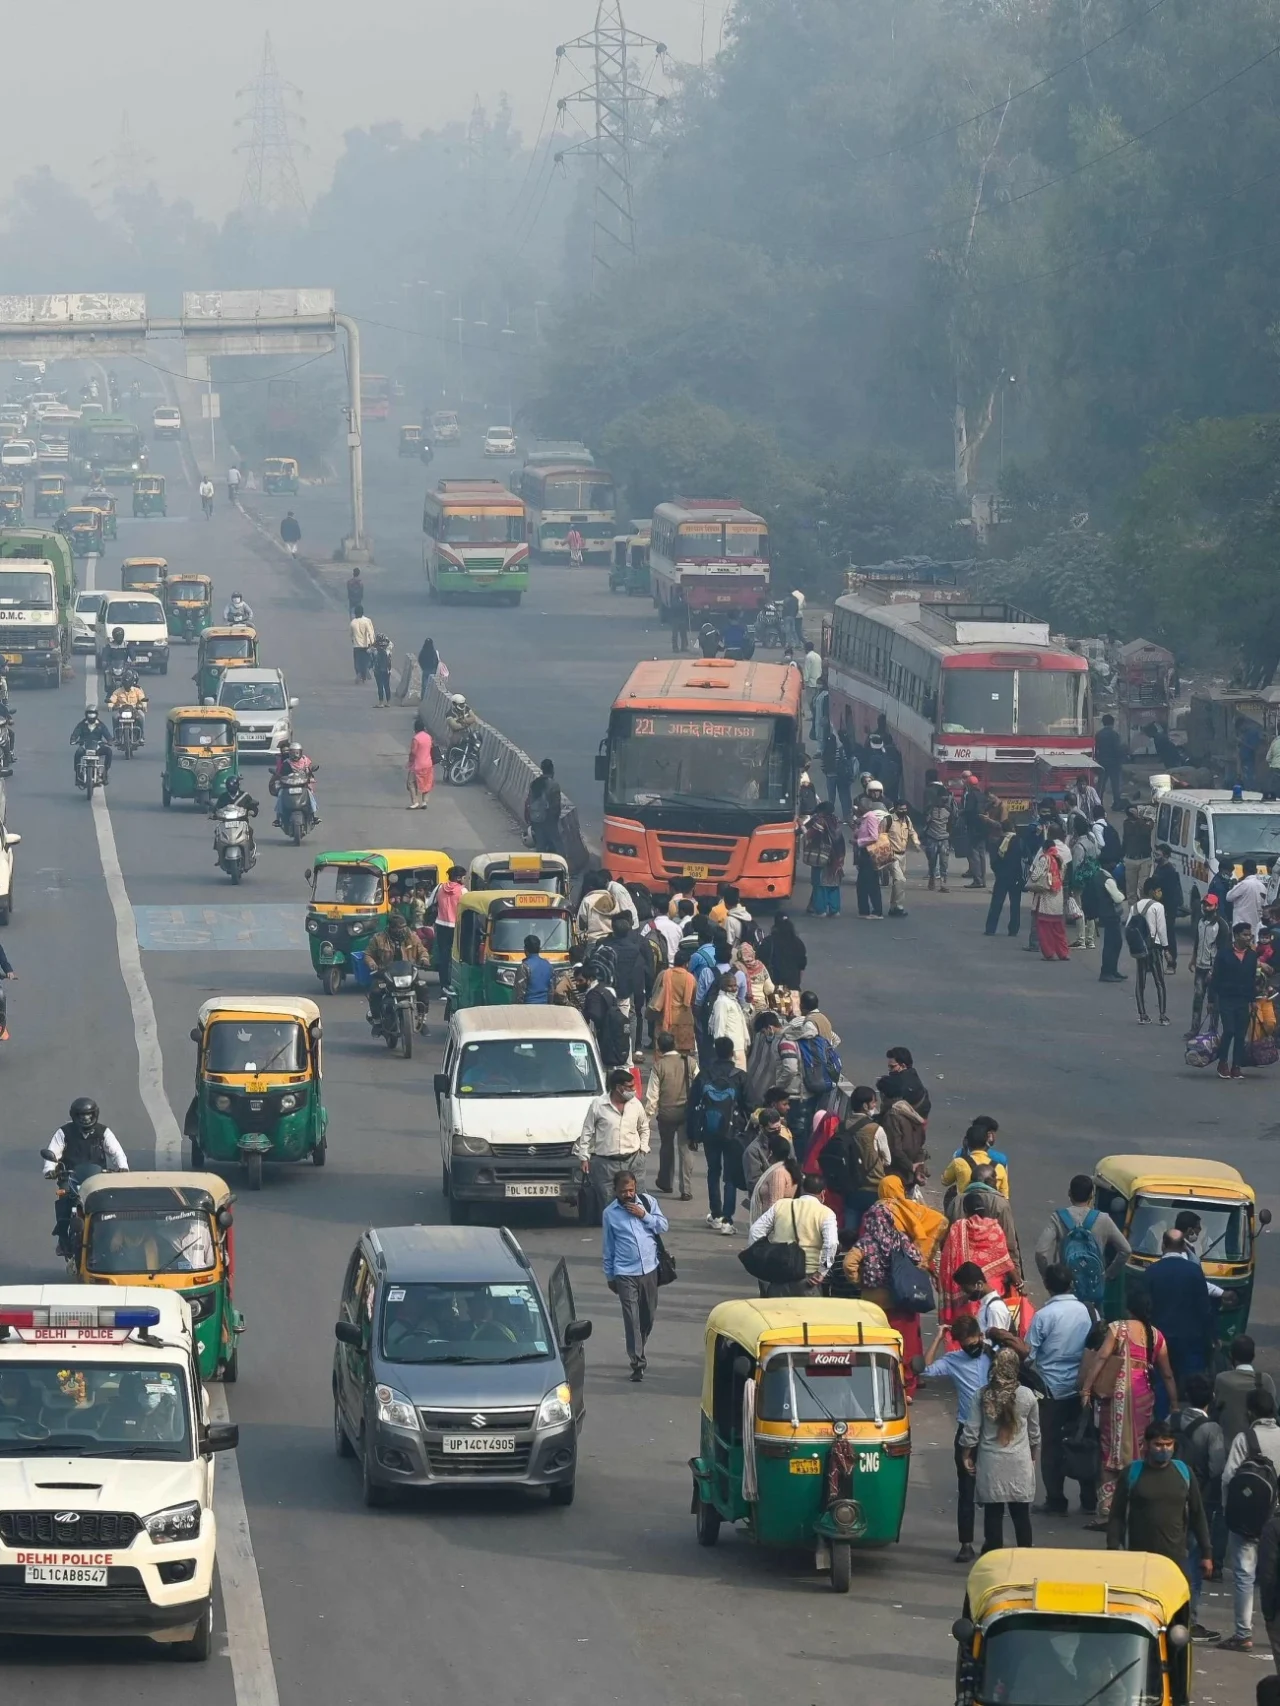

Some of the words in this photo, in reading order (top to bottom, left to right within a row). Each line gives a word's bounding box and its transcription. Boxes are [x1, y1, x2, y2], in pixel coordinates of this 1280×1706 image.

[635, 718, 655, 735] 221
[668, 721, 699, 737] आनंद
[702, 720, 731, 737] विहार
[954, 748, 971, 758] NCR
[540, 1186, 559, 1194] 8716
[35, 1329, 67, 1339] DELHI
[78, 1329, 113, 1339] POLICE
[815, 1354, 851, 1364] Komal
[450, 1439, 514, 1450] UP14CY4905
[860, 1452, 880, 1472] CNG
[17, 1553, 57, 1564] DELHI
[62, 1553, 112, 1564] POLICE
[33, 1568, 106, 1582] DL1CAB8547
